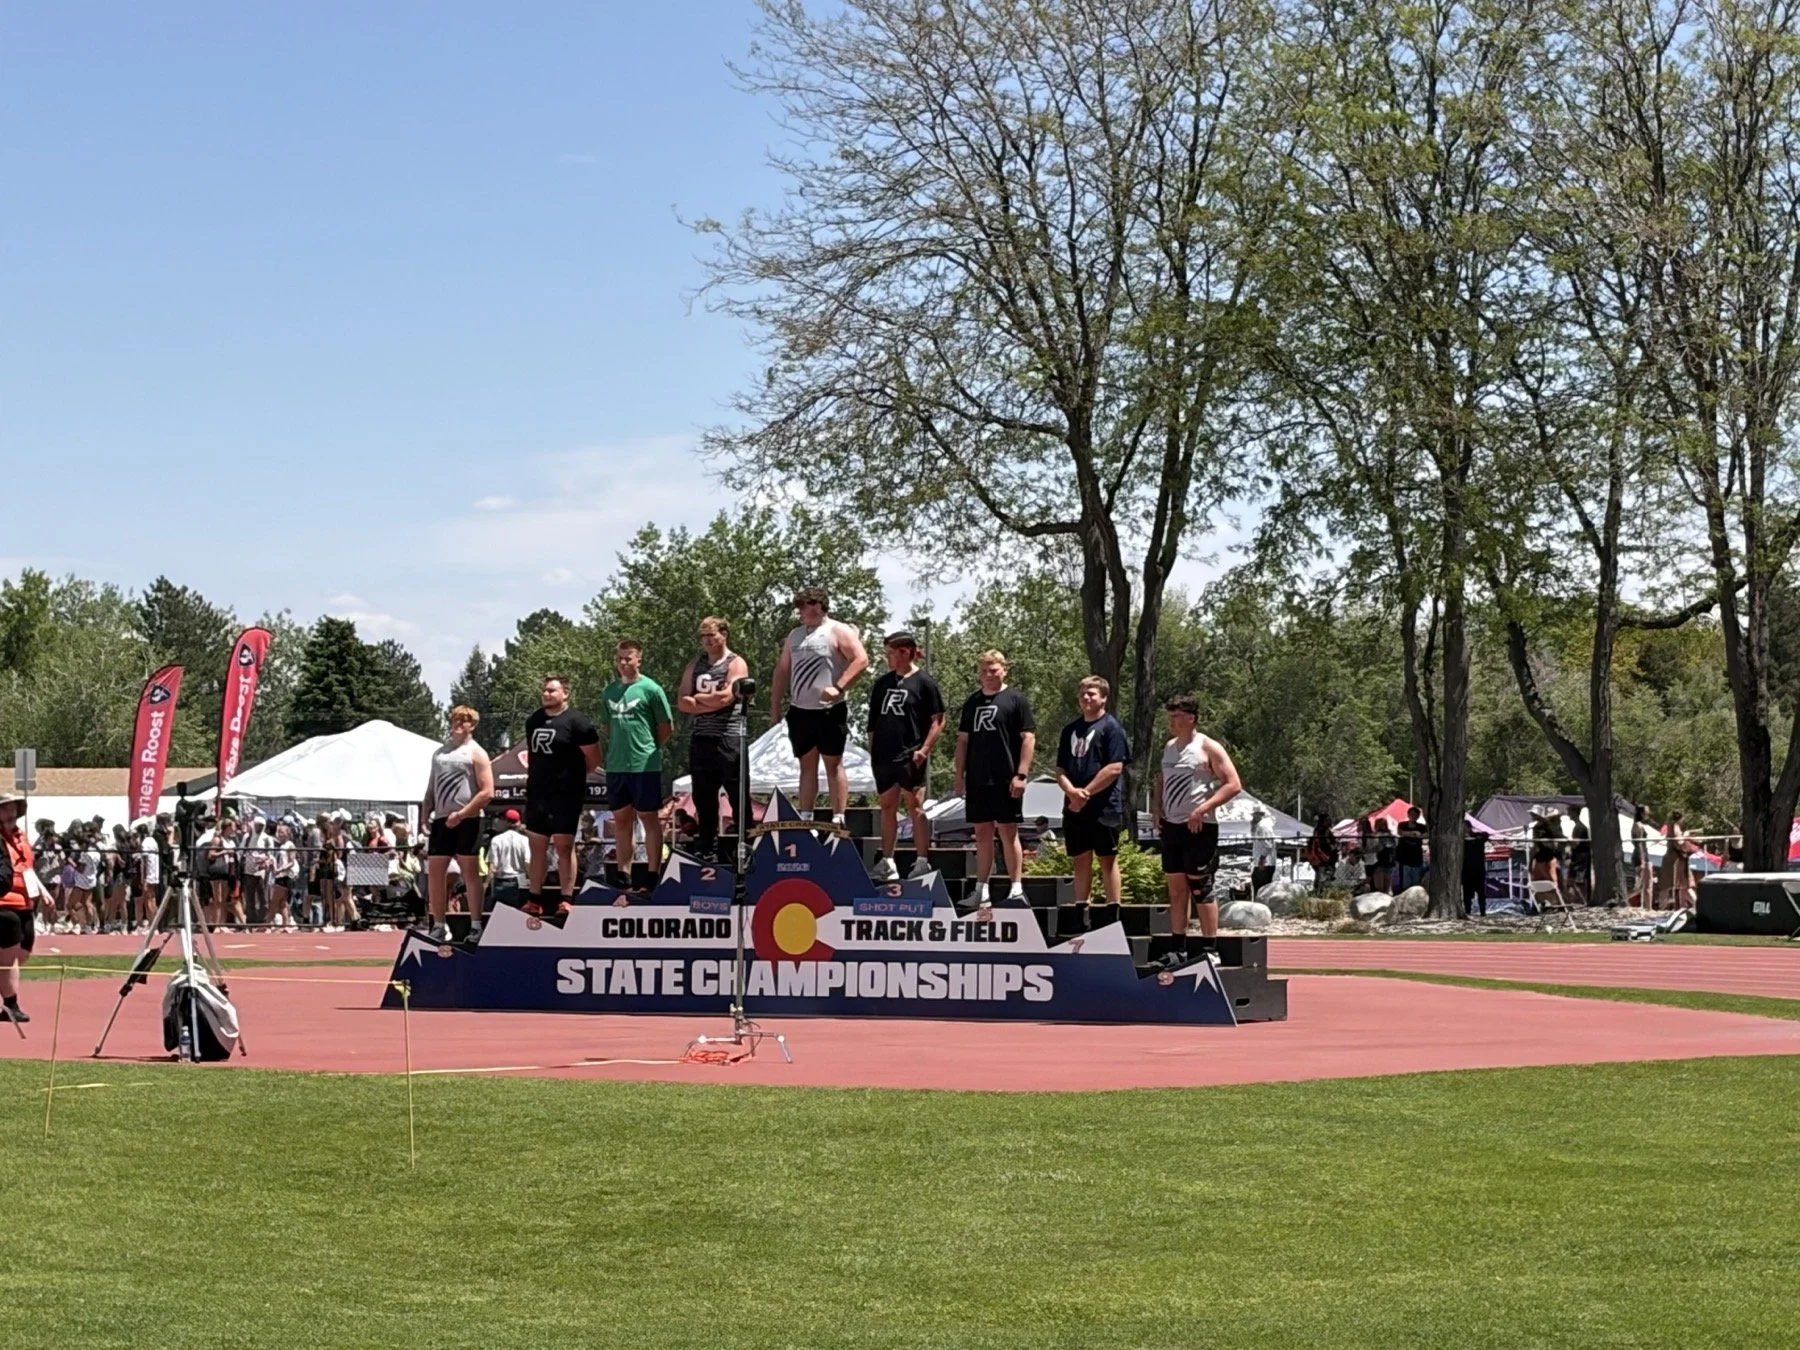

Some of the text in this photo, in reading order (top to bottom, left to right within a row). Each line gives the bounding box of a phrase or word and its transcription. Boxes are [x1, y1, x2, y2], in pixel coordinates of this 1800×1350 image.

[881, 689, 908, 716] R
[974, 705, 998, 732] R
[531, 728, 556, 754] R
[138, 711, 165, 818] nners Roost
[589, 786, 608, 795] 197
[784, 844, 797, 857] 1
[701, 867, 716, 881] 2
[886, 883, 902, 897] 3
[692, 900, 729, 911] BOYS
[859, 902, 926, 914] SHOT PUT
[602, 917, 1018, 943] COLORADO TRACK & FIELD
[1068, 938, 1085, 954] 7
[556, 958, 1054, 1001] STATE CHAMPIONSHIPS
[1156, 970, 1175, 986] 9
